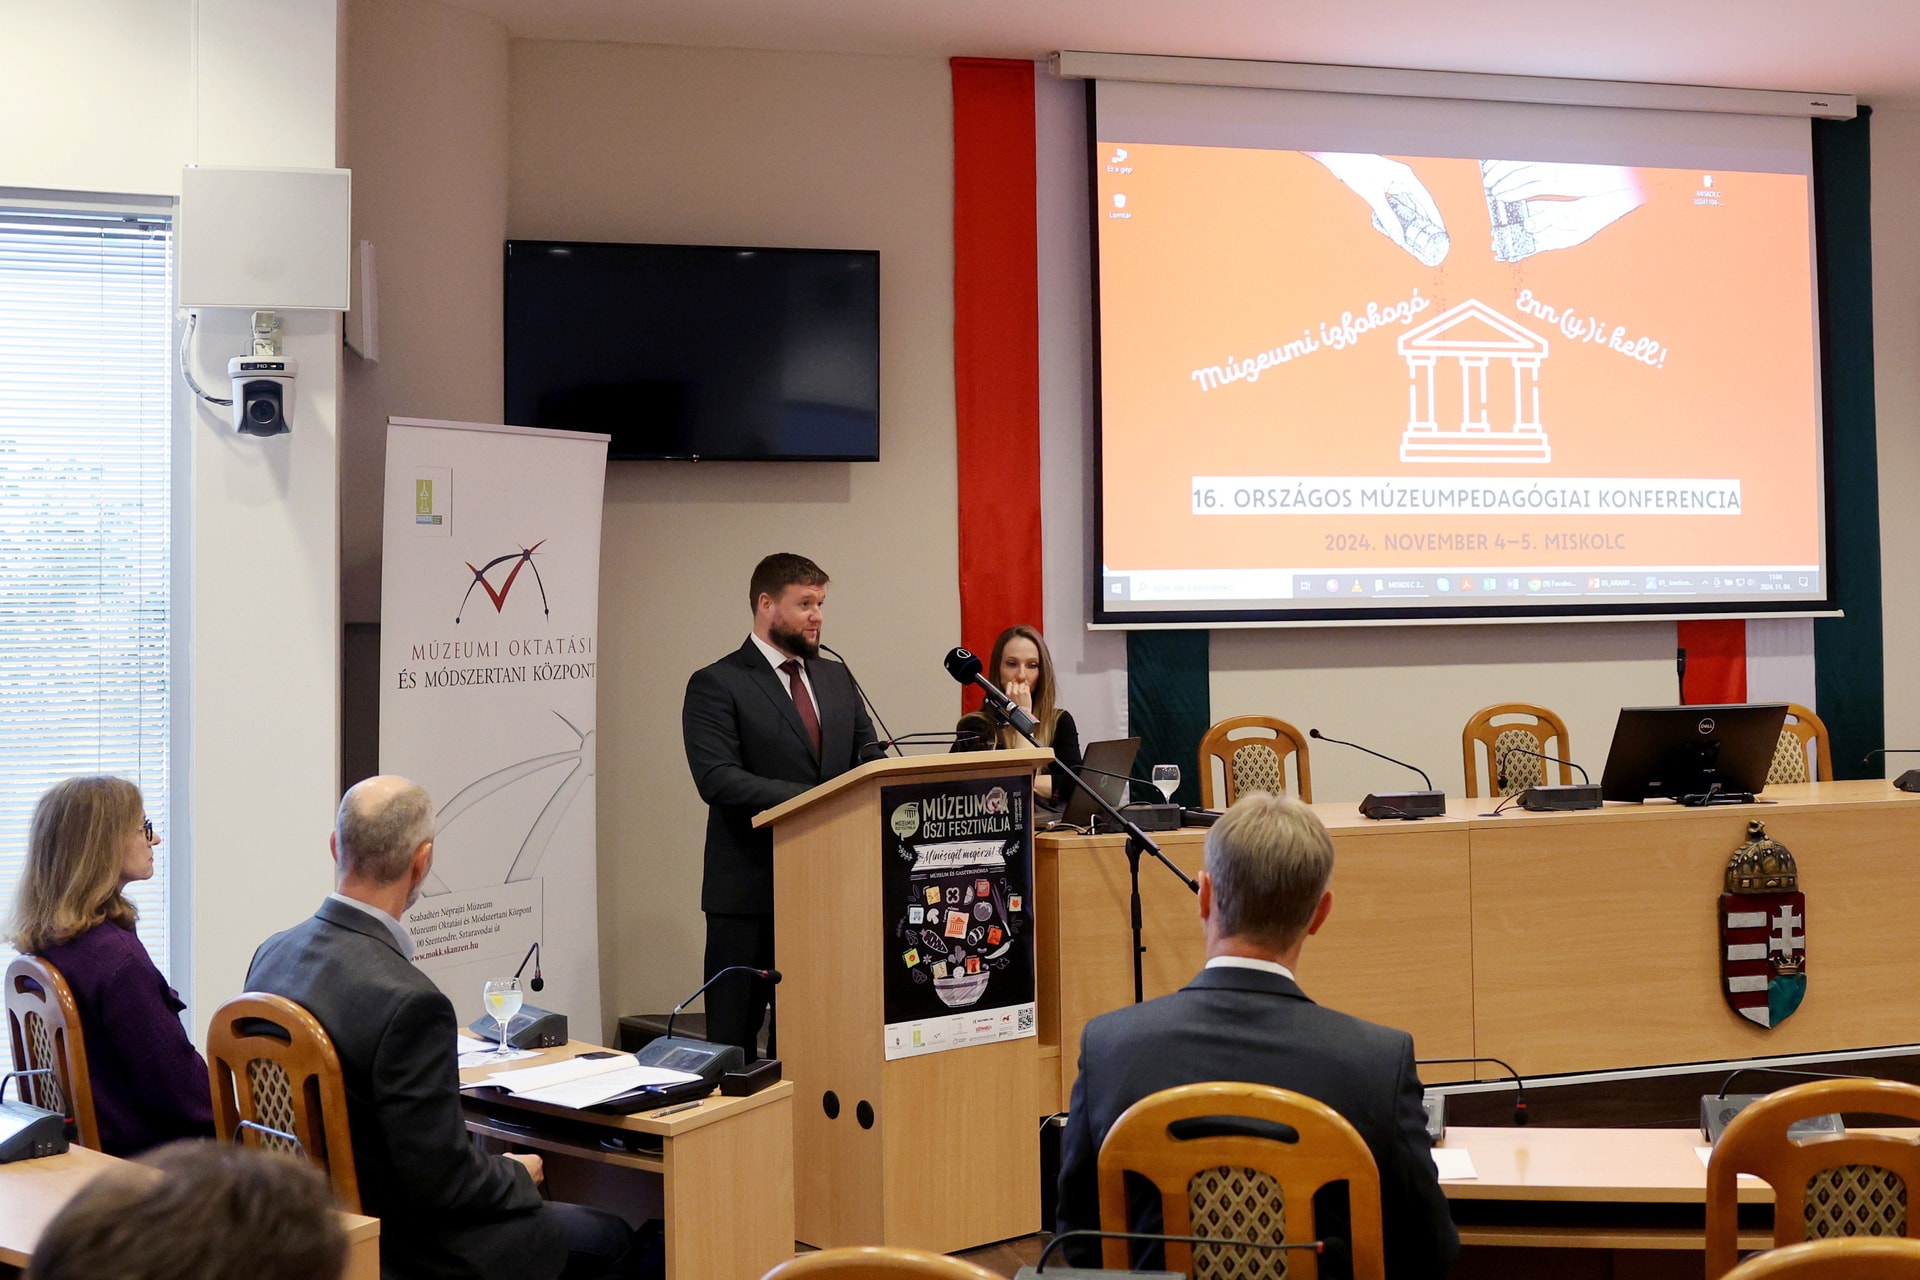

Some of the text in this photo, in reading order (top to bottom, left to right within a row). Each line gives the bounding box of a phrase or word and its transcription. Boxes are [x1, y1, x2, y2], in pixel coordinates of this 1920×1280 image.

[1191, 287, 1430, 392] Múzeumi ízfokozó
[1516, 289, 1668, 369] Enn(y)i kell!
[1193, 481, 1741, 509] 16. ORSZÁGOS MÚZEUMPEDAGÓGIAI KONFERENCIA
[1325, 533, 1377, 551] 2024.
[1384, 533, 1489, 551] NOVEMBER
[1544, 533, 1626, 550] MISKOLC
[411, 635, 592, 661] MÚZEUMI OKTATÁSI
[398, 662, 597, 690] ÉS MÓDSZERTANI KÖZPONT
[922, 821, 946, 839] ŐSZI
[948, 816, 1011, 837] FESZTIVÁLJA
[410, 900, 493, 923] Szabadtéri Néprajzi Múzeum
[410, 905, 532, 936] Múzeumi Oktatási és Módszertani Központ
